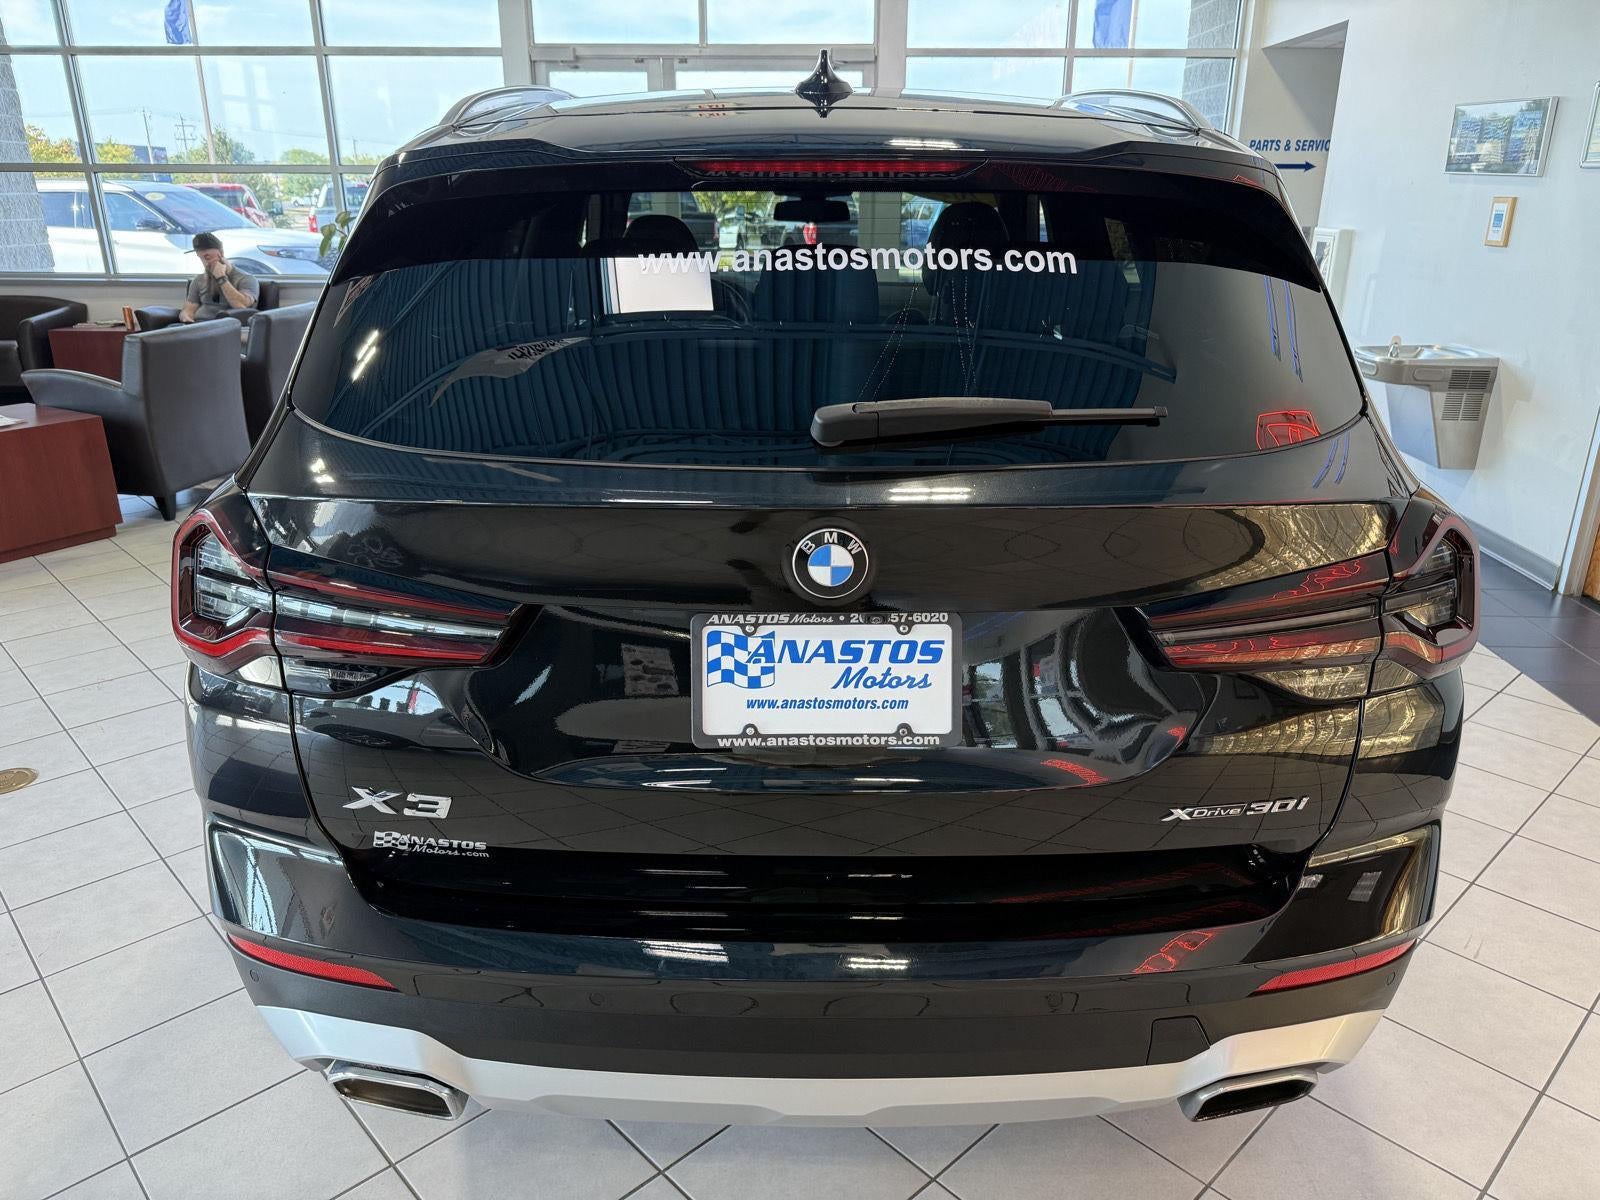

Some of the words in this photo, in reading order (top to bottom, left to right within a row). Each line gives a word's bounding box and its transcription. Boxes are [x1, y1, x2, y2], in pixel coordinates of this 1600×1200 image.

[1249, 139, 1281, 152] PARTS
[1284, 139, 1291, 152] &
[638, 242, 1077, 274] www.anastosmotors.com
[800, 531, 863, 555] BMW
[706, 613, 790, 625] ANASTOS
[790, 613, 834, 624] Motors
[746, 639, 945, 664] ANASTOS
[831, 666, 932, 689] Motors
[746, 696, 909, 710] www.anastosmotors.com
[717, 733, 940, 747] www.anastosmotors.com
[342, 786, 452, 819] X3
[1246, 796, 1310, 815] 30i
[399, 834, 487, 850] ANASTOS
